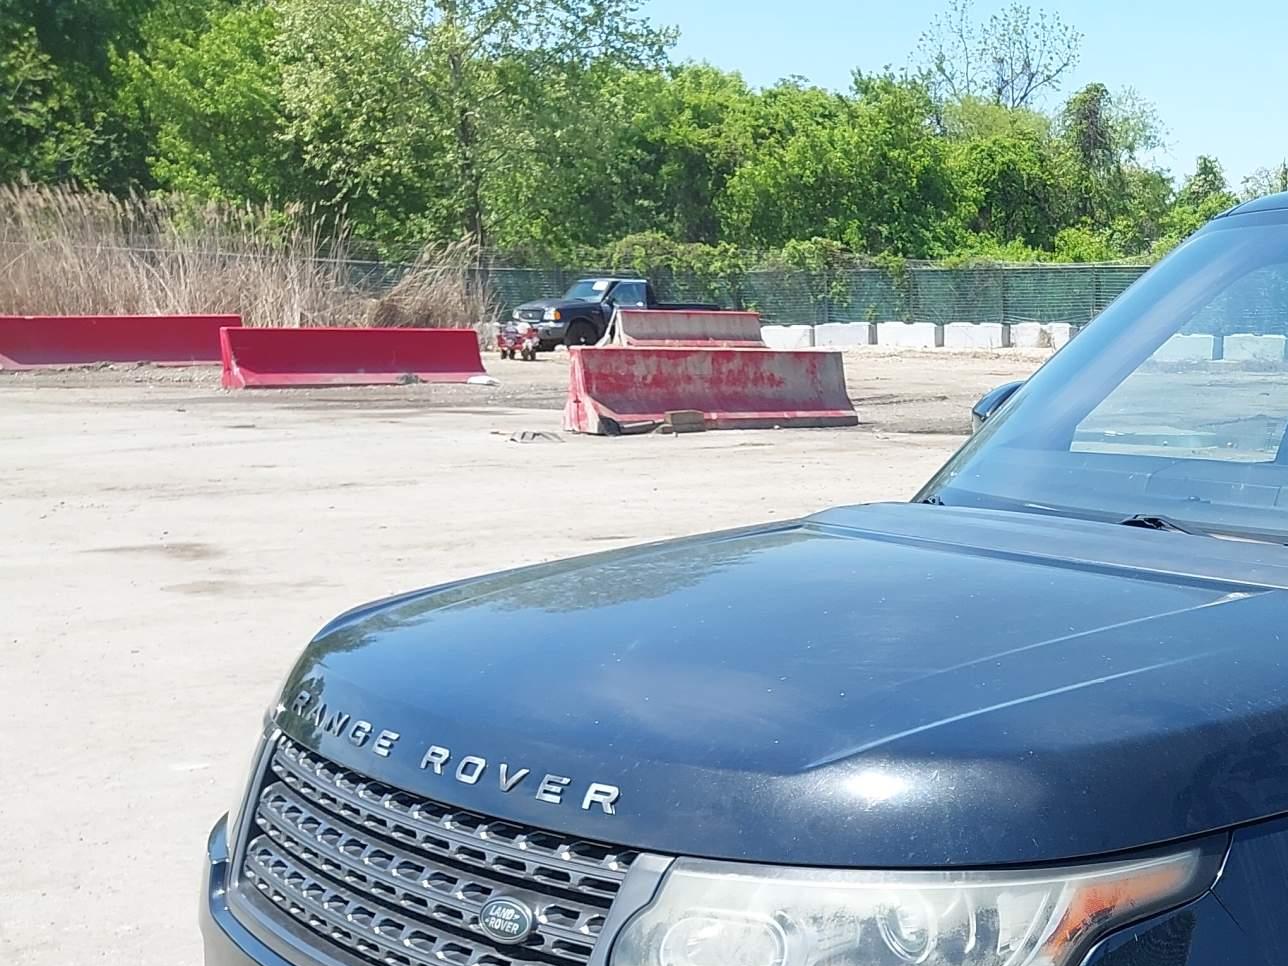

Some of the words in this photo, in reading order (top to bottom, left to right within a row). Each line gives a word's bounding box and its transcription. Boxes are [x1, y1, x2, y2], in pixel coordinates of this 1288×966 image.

[291, 690, 399, 756] RANGE
[420, 745, 620, 815] ROVER
[489, 904, 516, 920] LAND
[487, 917, 520, 935] ROVER
